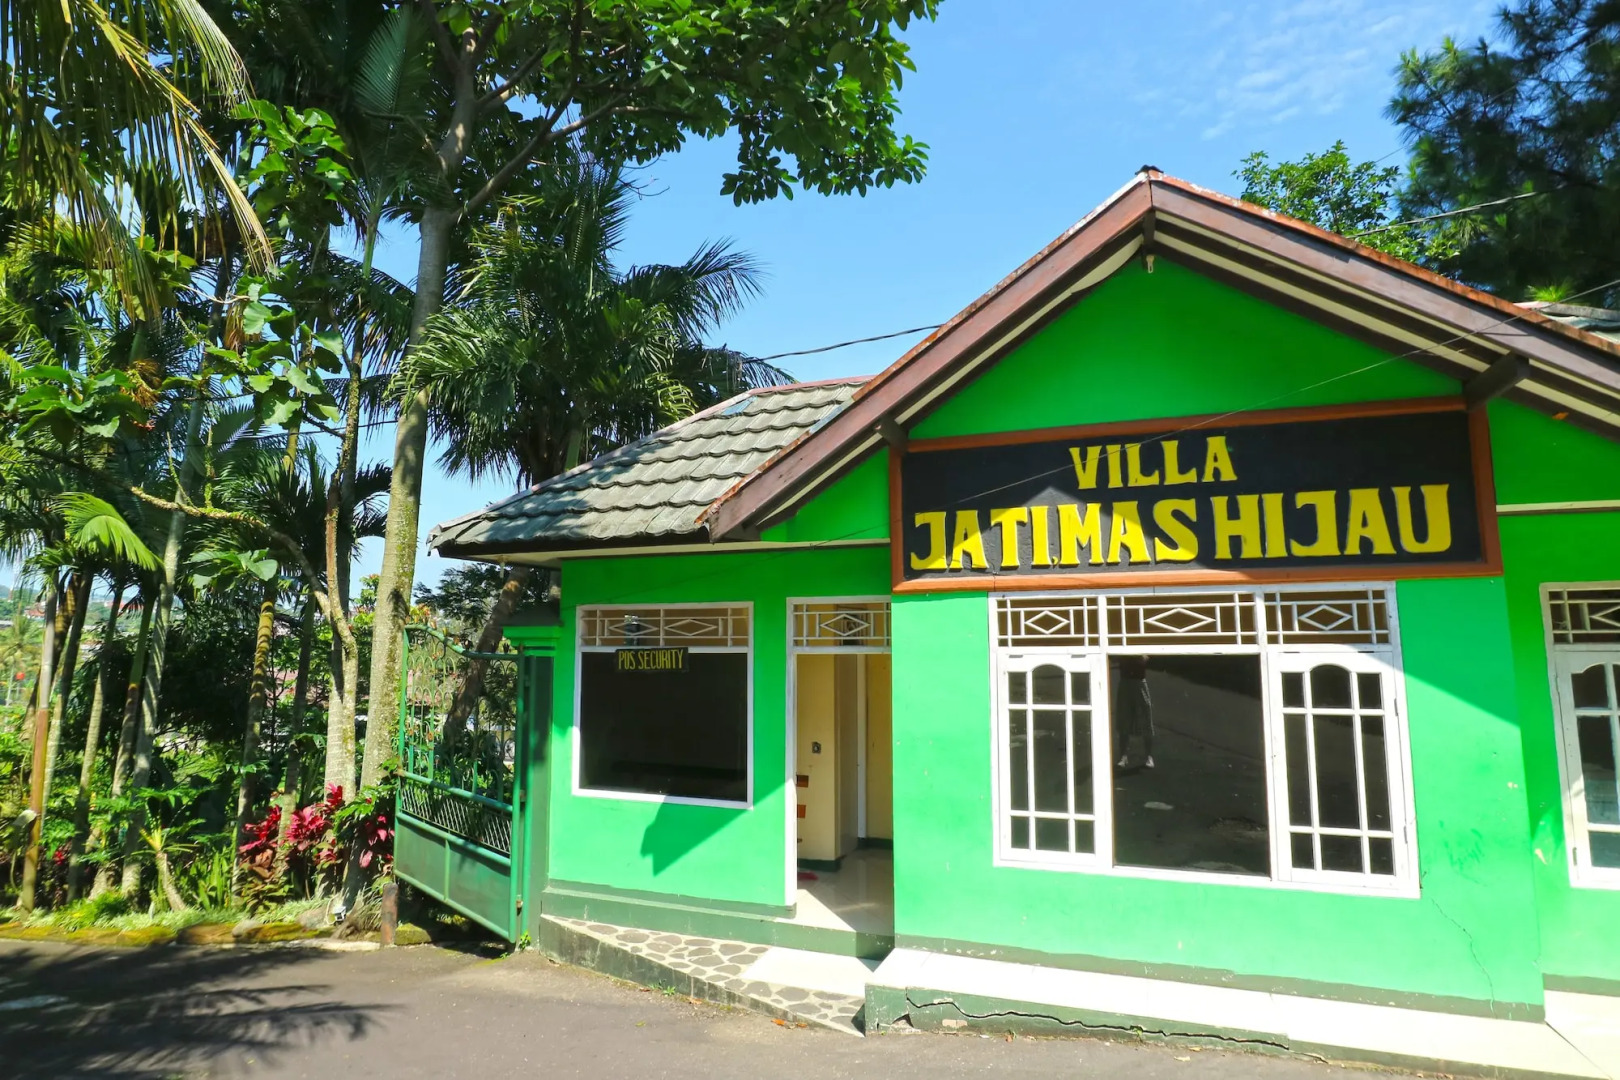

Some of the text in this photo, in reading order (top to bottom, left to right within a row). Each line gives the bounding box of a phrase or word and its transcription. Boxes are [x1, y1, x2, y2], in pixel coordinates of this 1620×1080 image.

[1068, 436, 1238, 490] VILLA
[1210, 484, 1452, 559] HIJAU
[618, 648, 684, 670] POS SECURITY
